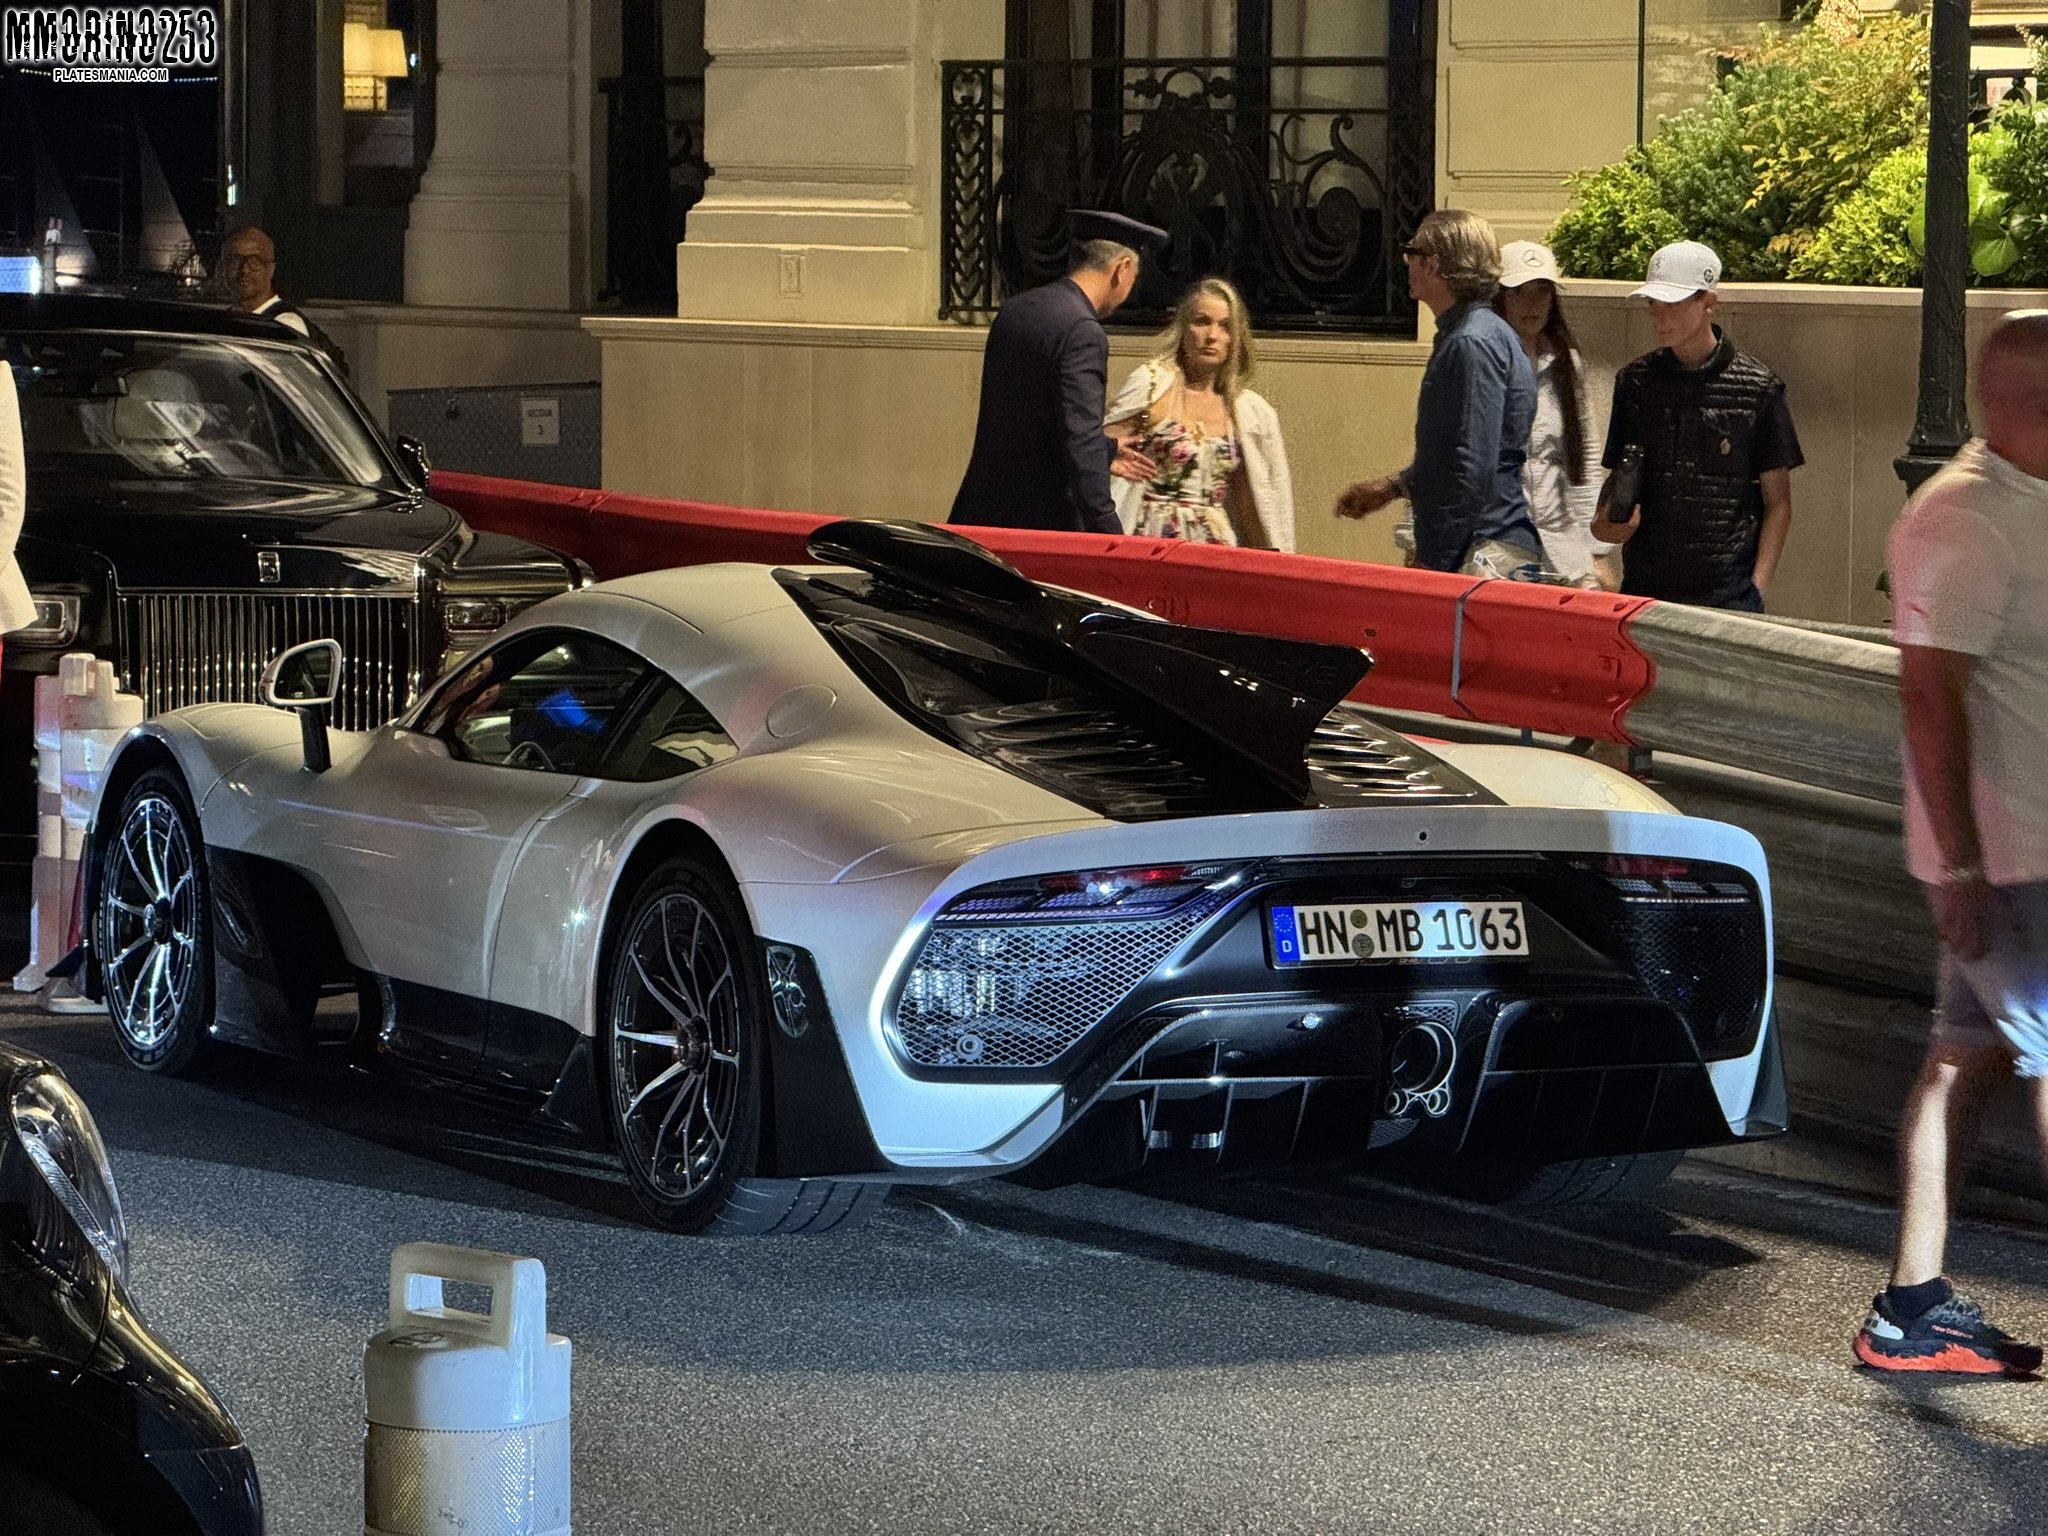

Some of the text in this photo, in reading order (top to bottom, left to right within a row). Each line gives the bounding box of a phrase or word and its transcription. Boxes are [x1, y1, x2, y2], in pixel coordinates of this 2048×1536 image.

[1281, 940, 1293, 953] D
[1299, 908, 1522, 955] HN MB 1063
